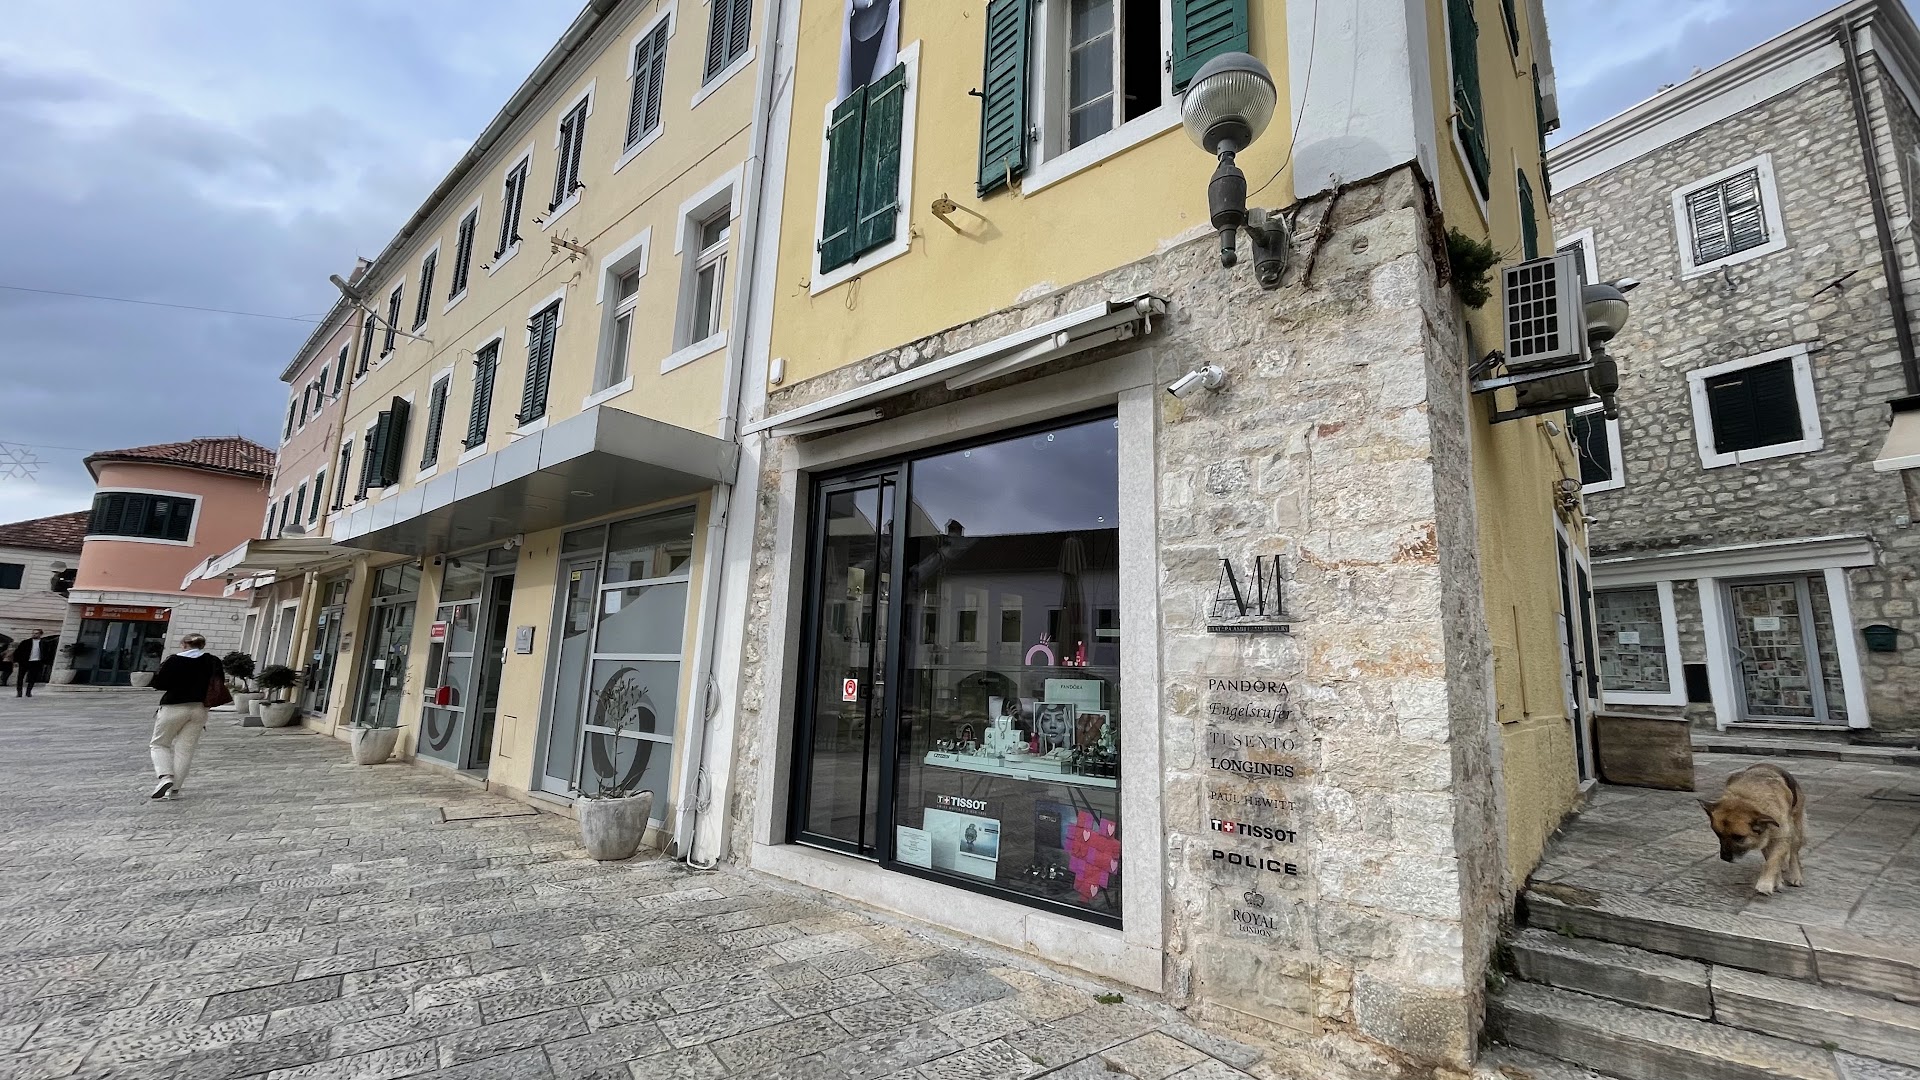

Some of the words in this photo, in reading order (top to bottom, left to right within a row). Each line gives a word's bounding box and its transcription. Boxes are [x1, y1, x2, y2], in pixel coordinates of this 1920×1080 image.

[1208, 679, 1289, 694] PANDORA
[1209, 702, 1293, 724] Engelsrufer
[1210, 757, 1294, 778] LONGINES
[950, 796, 988, 811] TISSOT
[1210, 791, 1240, 804] PAUL
[1244, 795, 1296, 811] HEWITT
[1236, 822, 1297, 843] TISSOT
[1212, 849, 1297, 876] POLICE
[1232, 908, 1278, 930] ROYAL
[1239, 924, 1271, 937] LONDON
